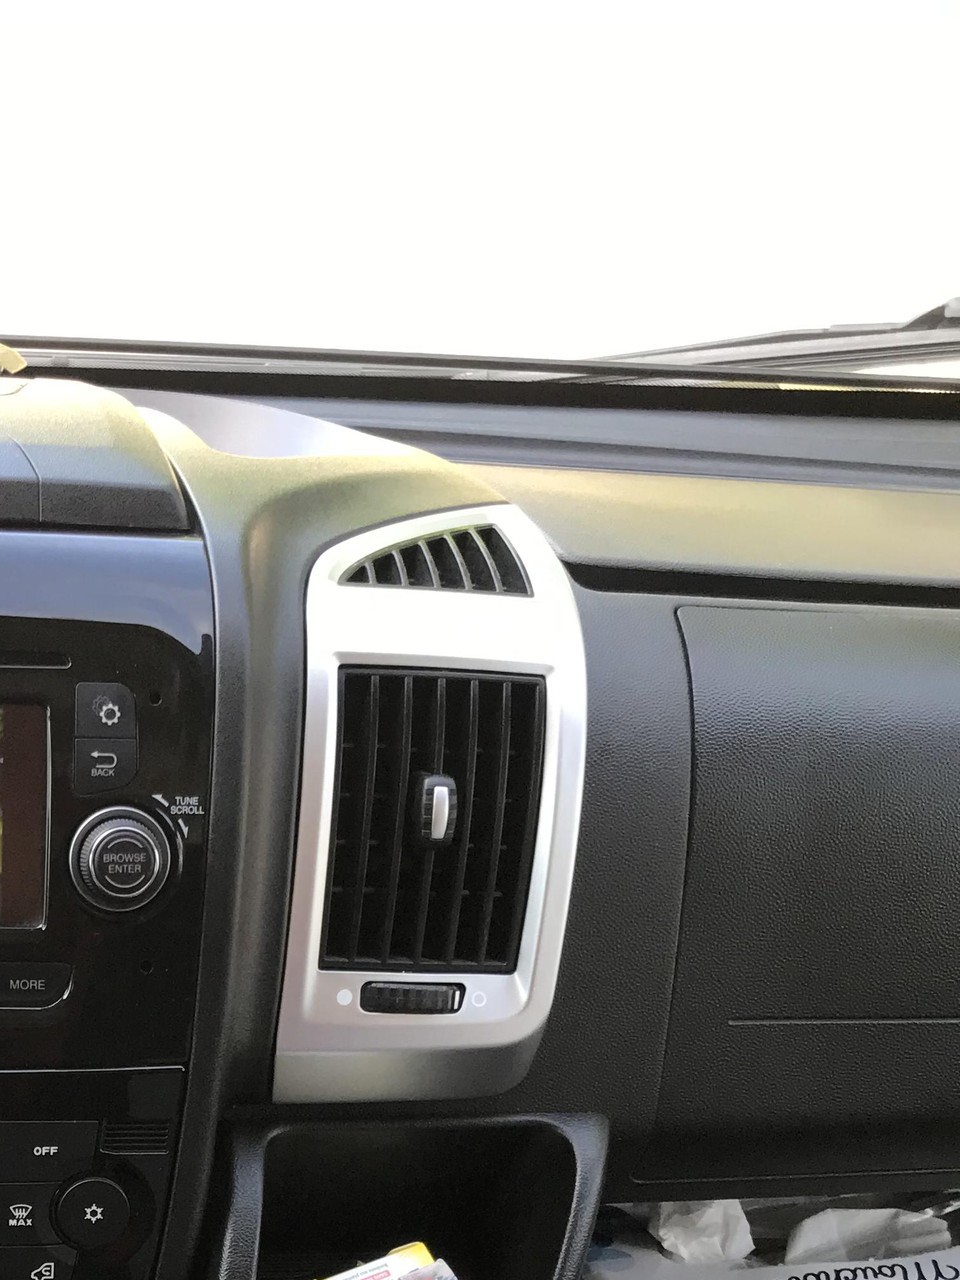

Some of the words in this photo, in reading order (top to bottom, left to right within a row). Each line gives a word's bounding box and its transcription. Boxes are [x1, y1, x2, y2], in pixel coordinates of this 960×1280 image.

[91, 769, 115, 777] BACK
[175, 796, 199, 805] TUNE
[170, 806, 204, 815] SCROLL
[103, 853, 146, 863] BROWSE
[108, 864, 142, 874] ENTER
[9, 979, 46, 990] MORE
[33, 1146, 59, 1156] OFF
